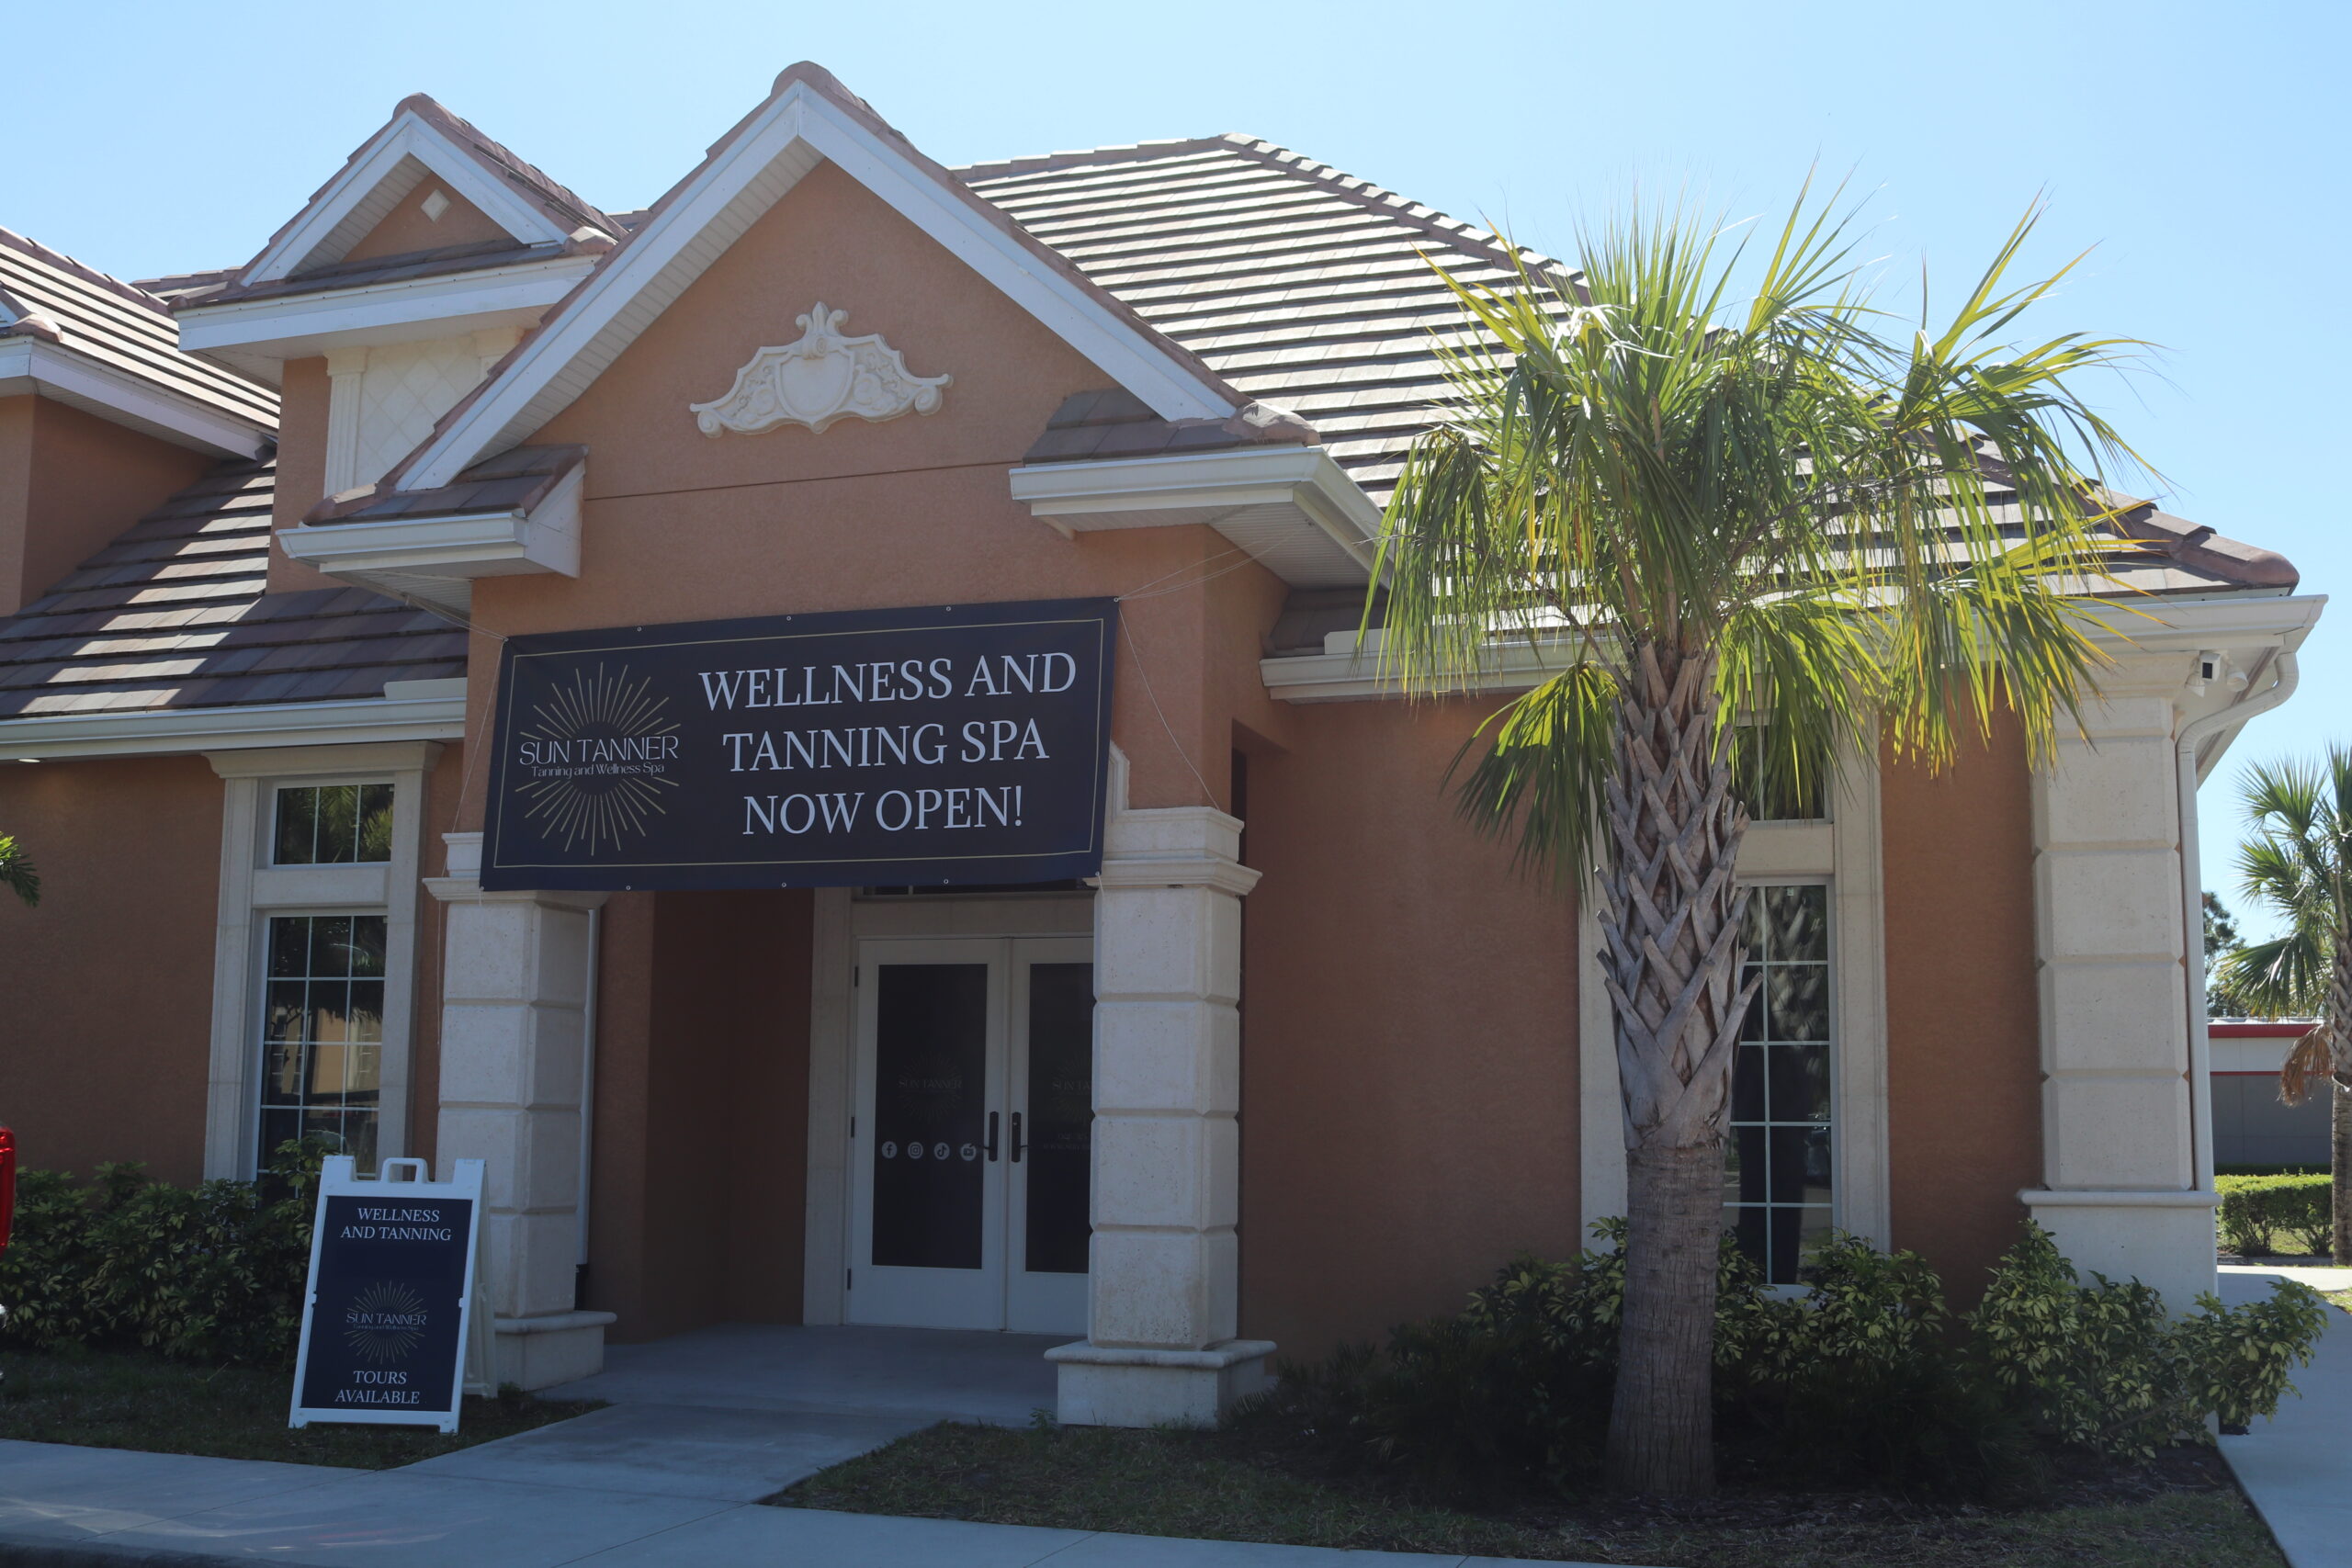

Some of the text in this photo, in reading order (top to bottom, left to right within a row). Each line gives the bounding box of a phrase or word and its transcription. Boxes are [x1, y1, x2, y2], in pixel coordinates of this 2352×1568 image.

[698, 652, 1076, 711] WELLNESS AND
[519, 735, 679, 765] SUN TANNER
[722, 718, 1049, 772] TANNING SPA
[531, 761, 664, 779] Tanning and Wellness Spa
[742, 785, 1022, 835] NOW OPEN!
[357, 1207, 440, 1223] WELLNESS
[341, 1225, 452, 1241] AND TANNING
[345, 1313, 426, 1325] SUN TANNER
[353, 1371, 407, 1384] TOURS
[334, 1389, 420, 1404] AVAILABLE
